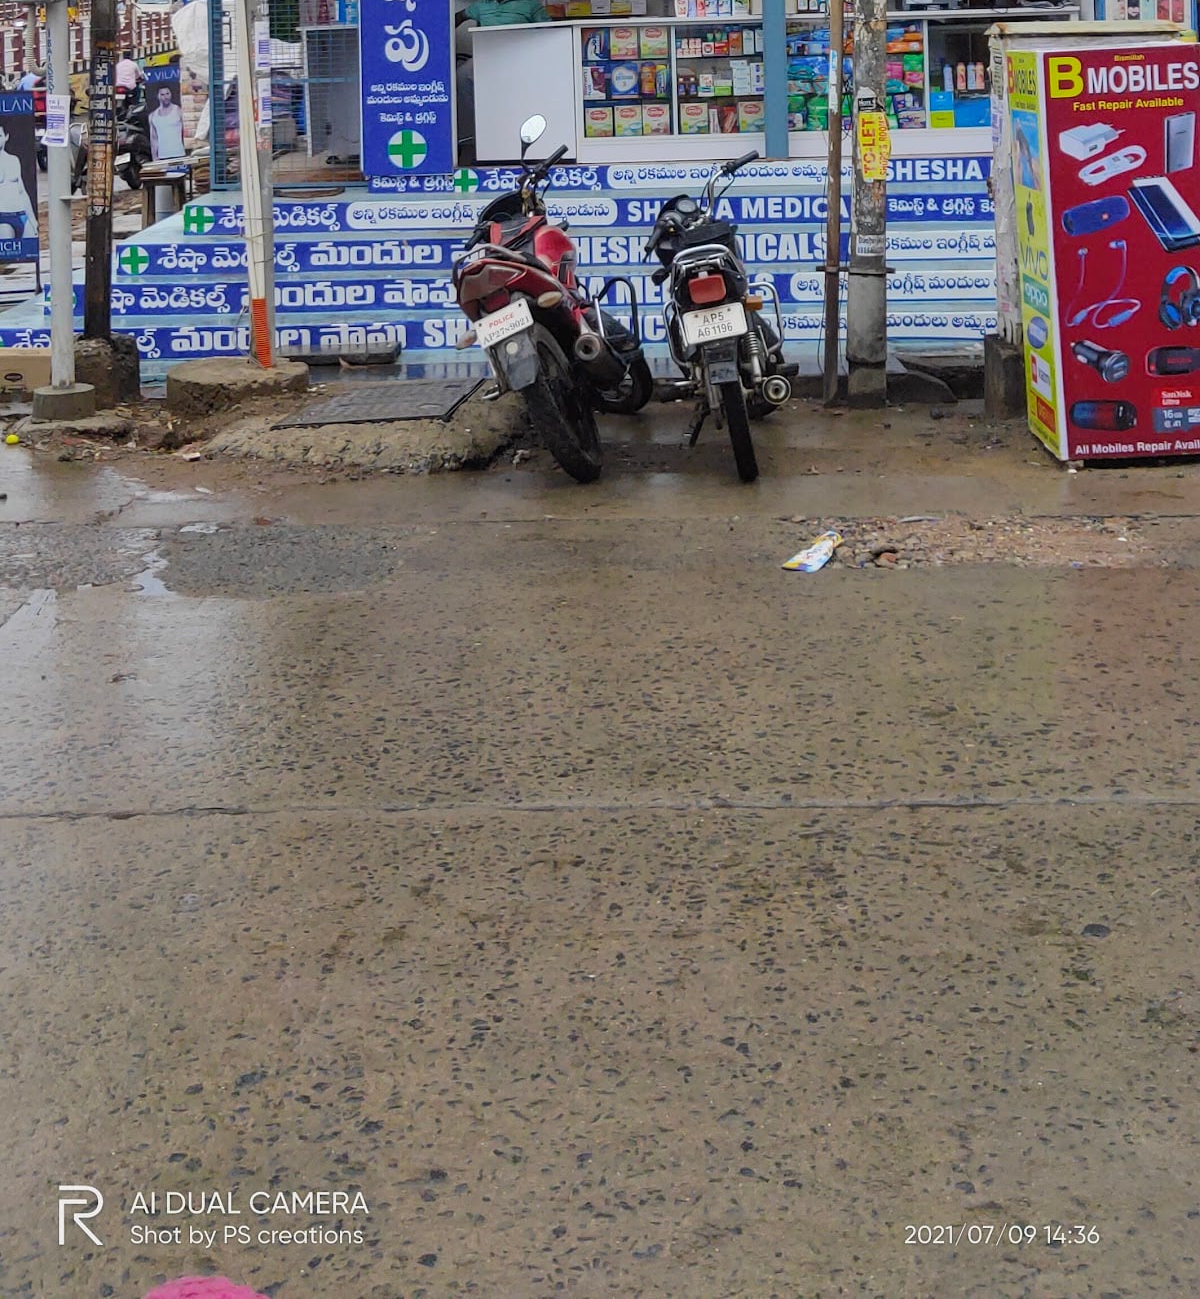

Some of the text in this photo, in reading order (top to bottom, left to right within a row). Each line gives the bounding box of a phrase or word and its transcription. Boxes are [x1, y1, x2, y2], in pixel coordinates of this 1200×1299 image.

[1048, 56, 1084, 98] B
[1087, 62, 1200, 94] MOBILES
[1073, 97, 1184, 112] Fast Repair Available
[613, 167, 636, 184] అన్ని
[638, 166, 685, 179] రకముల
[885, 160, 983, 181] SHESHA
[926, 198, 939, 211] &
[353, 207, 377, 224] అన్ని
[378, 207, 429, 220] రకముల
[157, 244, 208, 273] శేషా
[310, 241, 443, 266] మందుల
[929, 276, 990, 289] మందులు
[139, 284, 230, 313] మెడికల్స్
[488, 312, 514, 329] POLICE
[703, 312, 724, 325] AP5
[1075, 445, 1089, 455] All
[1092, 443, 1134, 454] Mobiles
[1137, 441, 1172, 453] Repair
